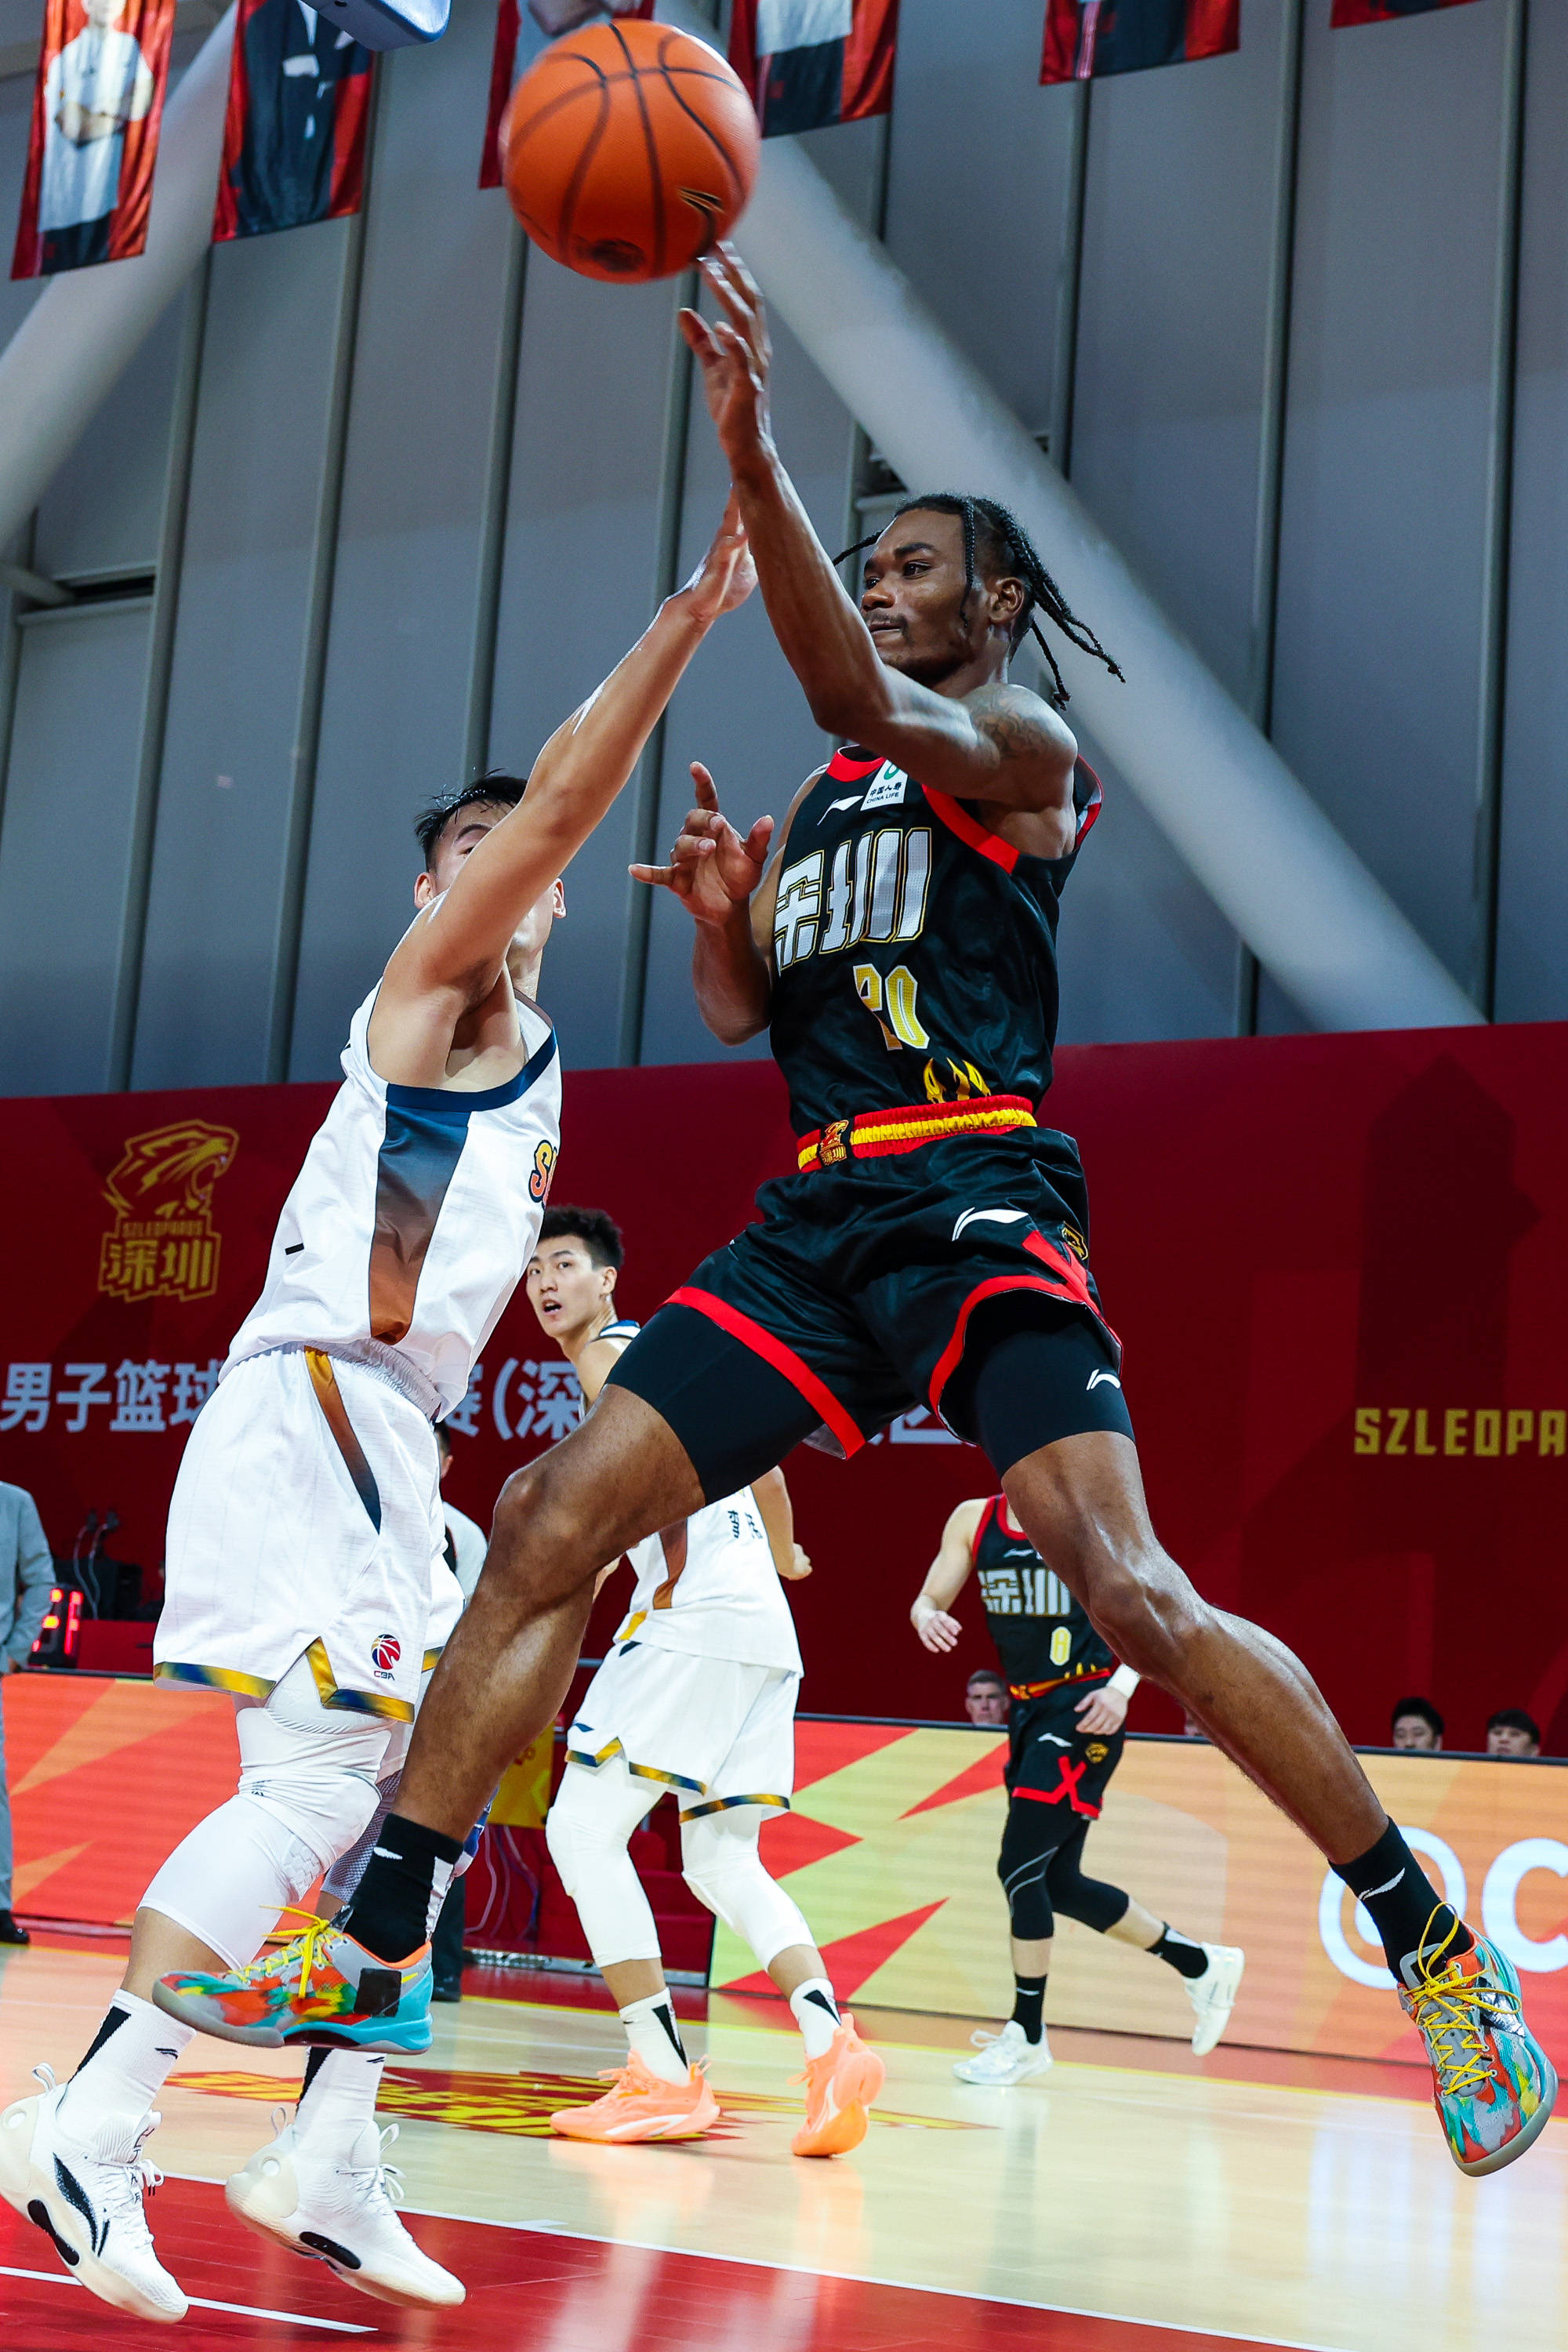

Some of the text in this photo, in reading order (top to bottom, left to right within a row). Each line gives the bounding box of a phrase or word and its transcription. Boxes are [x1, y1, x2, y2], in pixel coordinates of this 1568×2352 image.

[866, 795, 884, 804] CHINA
[528, 1139, 557, 1210] S
[106, 1239, 213, 1290] 深圳
[1354, 1407, 1566, 1457] SZLEOPA
[977, 1568, 1072, 1617] 深圳
[373, 1670, 395, 1682] CBA
